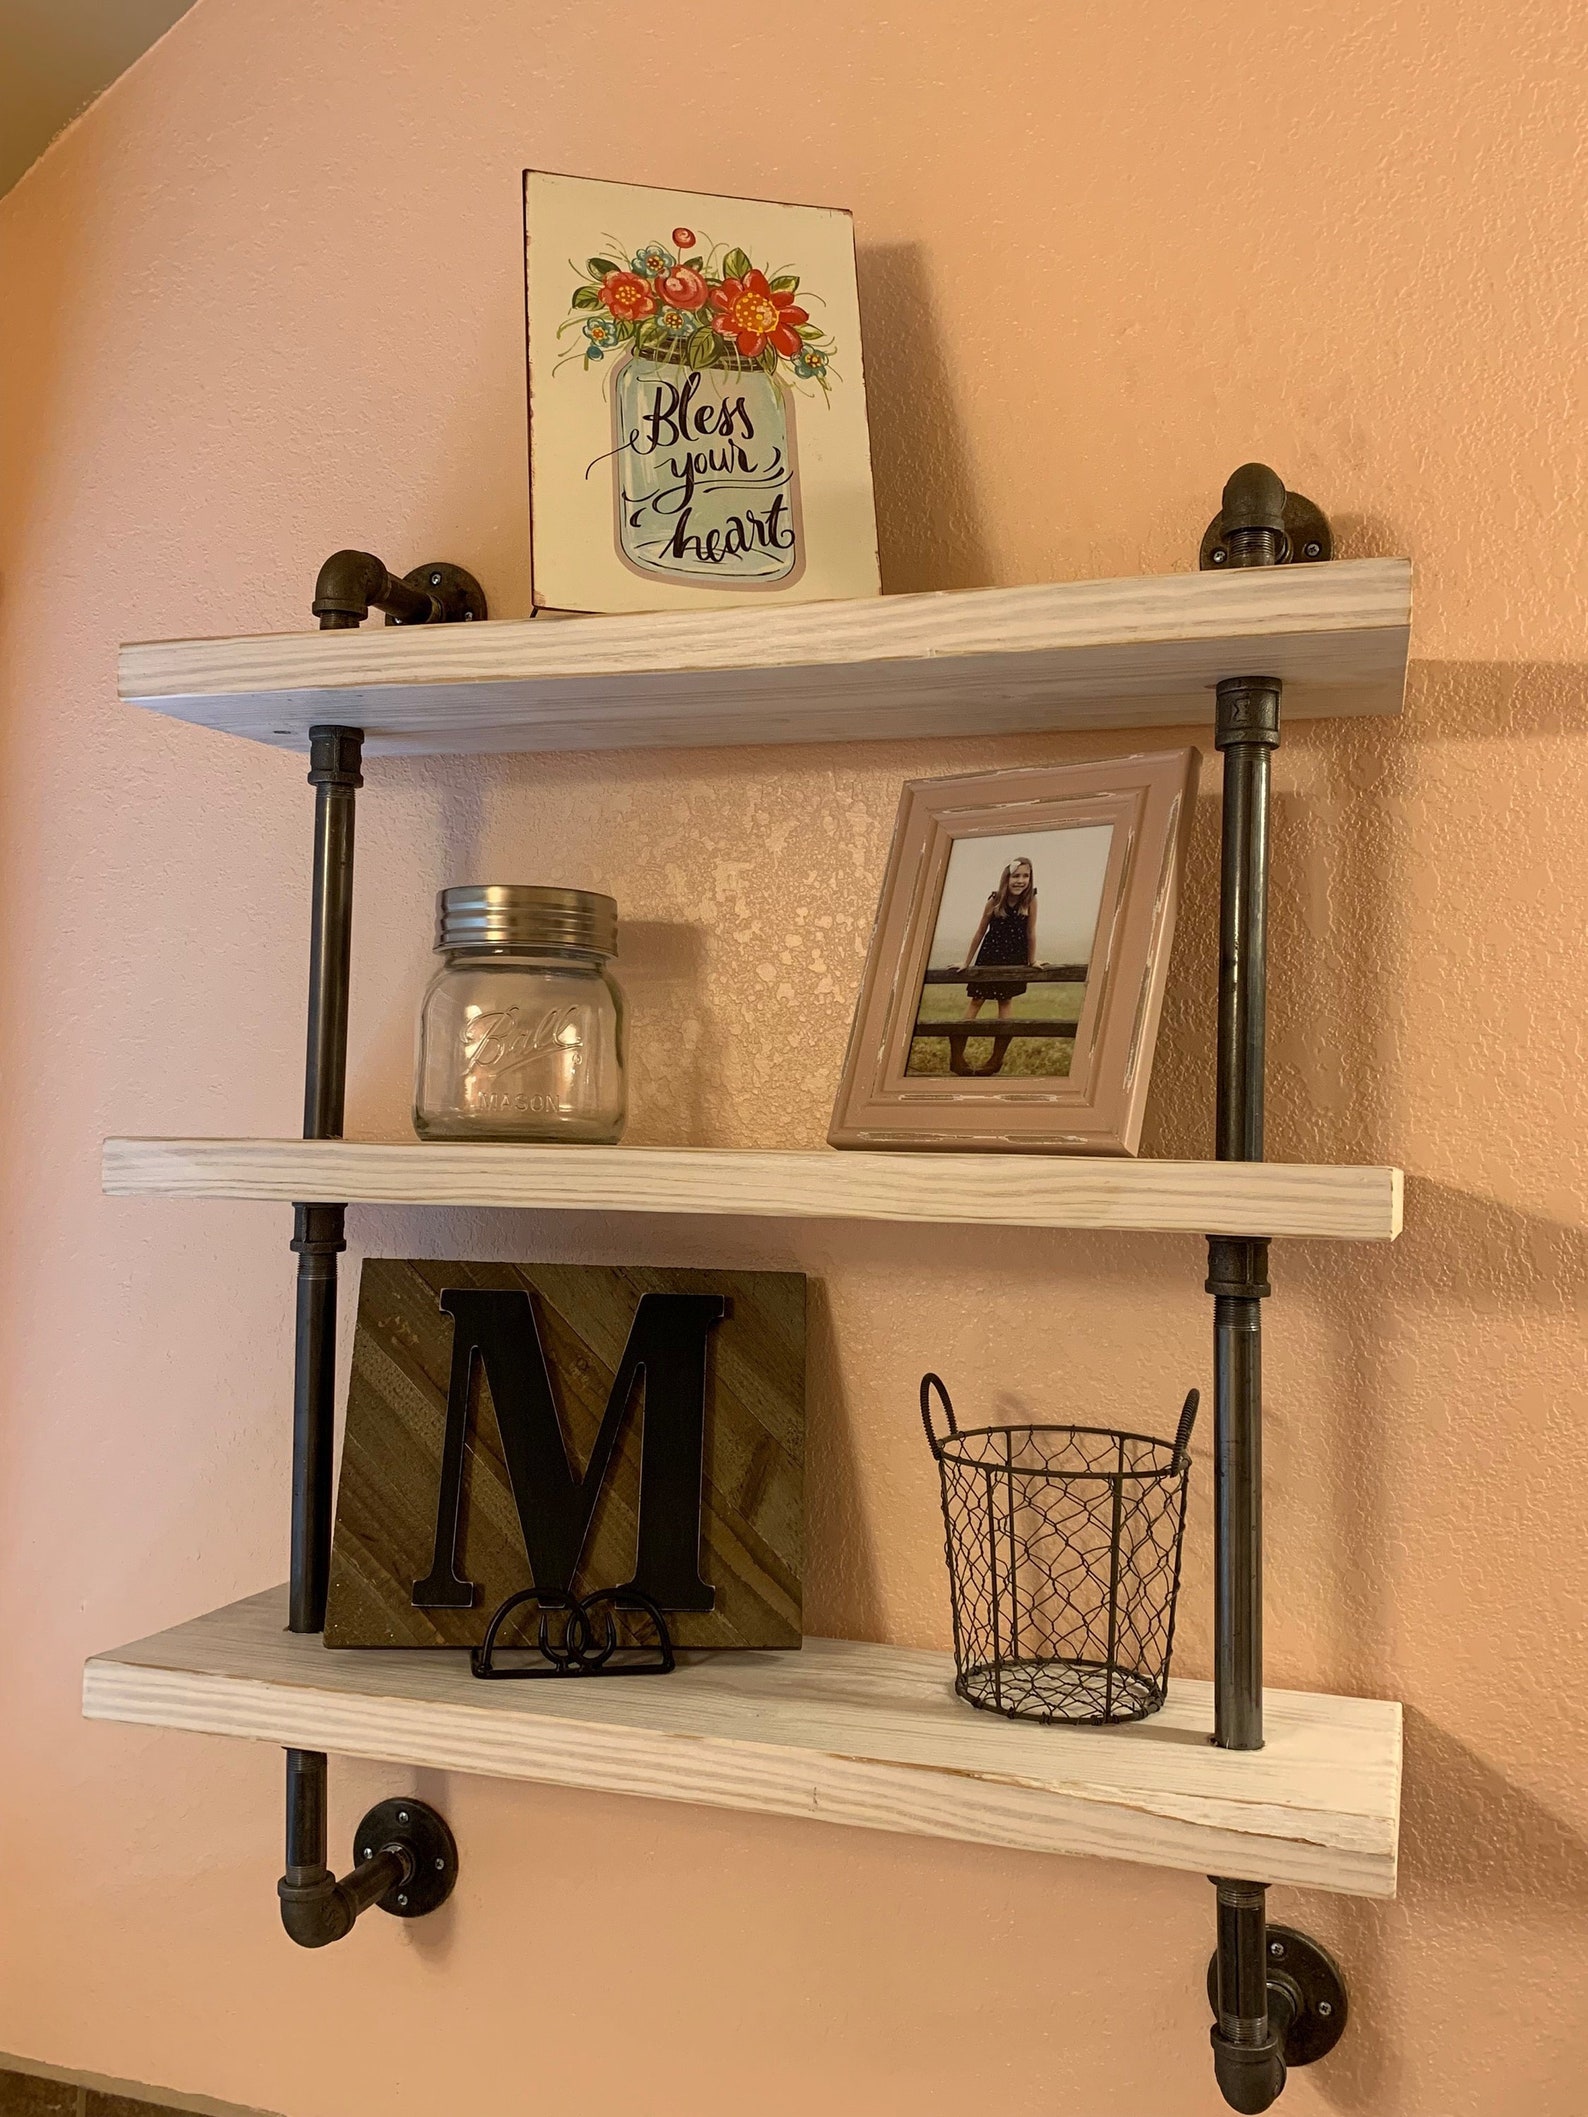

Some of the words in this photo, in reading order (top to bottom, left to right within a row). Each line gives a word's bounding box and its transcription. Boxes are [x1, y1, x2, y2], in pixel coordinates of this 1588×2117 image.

[630, 371, 755, 456] Bless
[652, 438, 759, 514] your
[658, 494, 796, 562] heart
[460, 1005, 584, 1077] Ball
[477, 1091, 561, 1113] MASON
[410, 1287, 726, 1613] M
